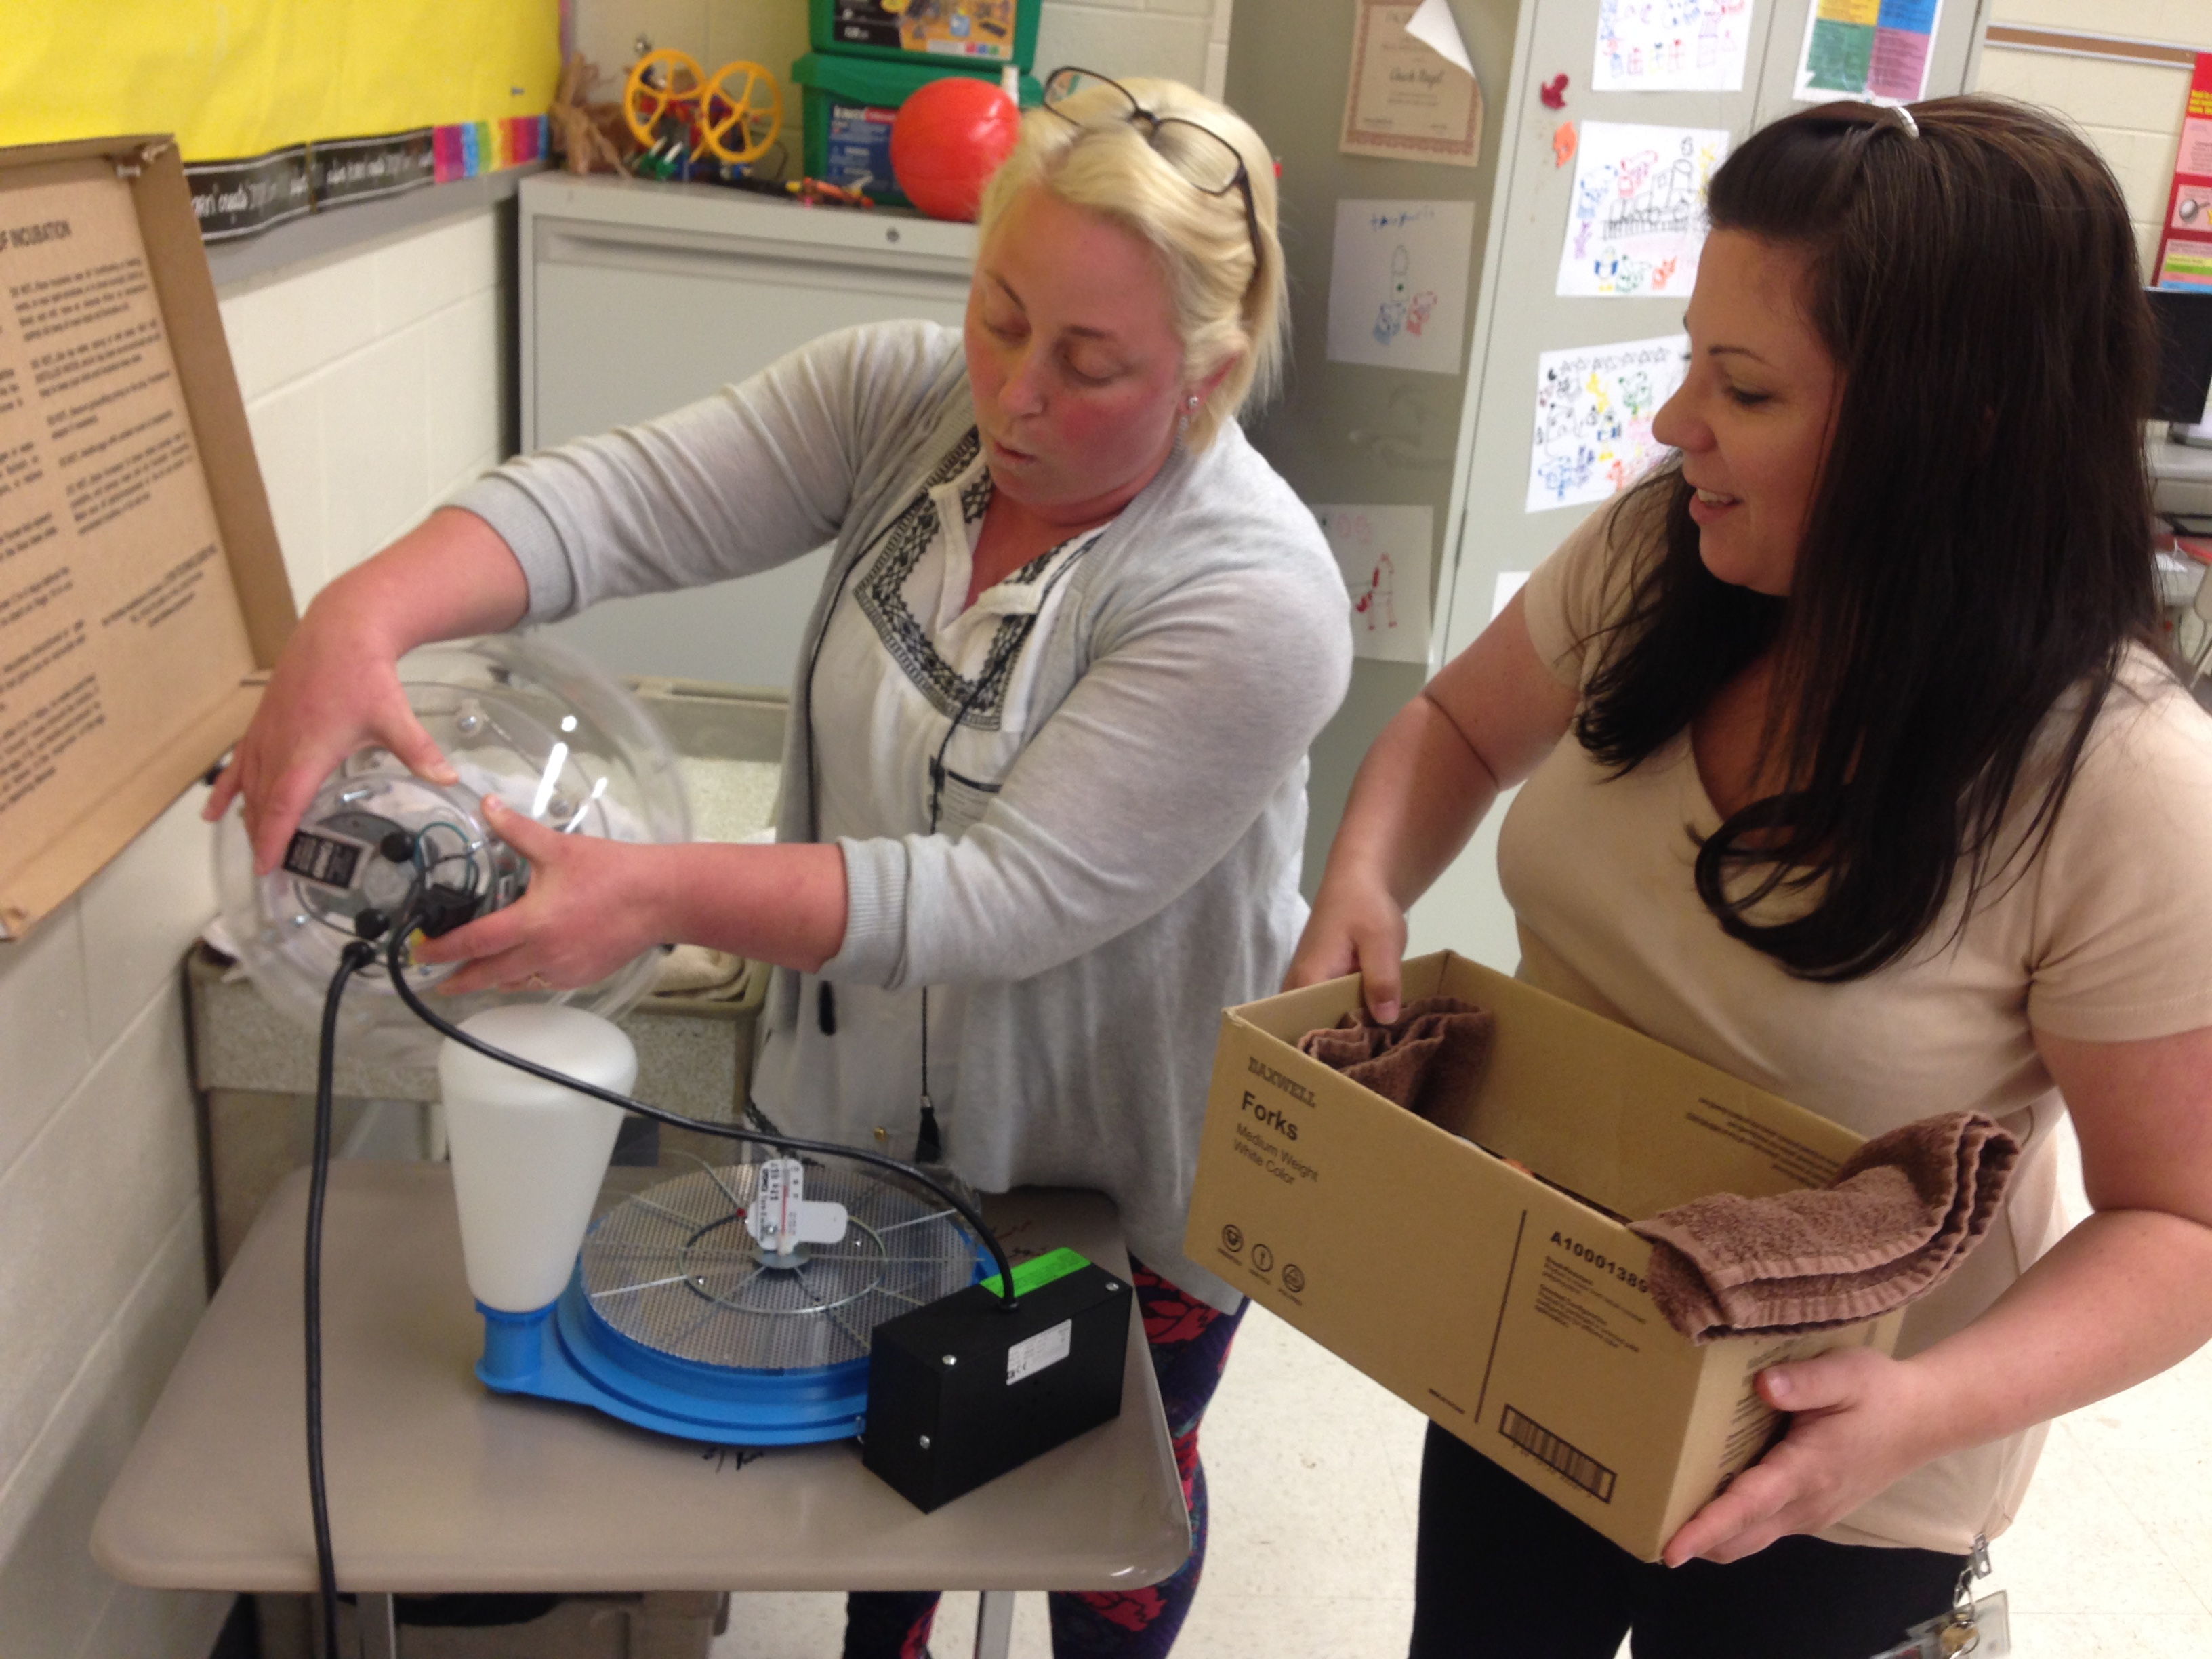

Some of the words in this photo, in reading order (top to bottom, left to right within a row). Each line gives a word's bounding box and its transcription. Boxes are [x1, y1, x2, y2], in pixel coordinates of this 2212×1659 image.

[1248, 1057, 1317, 1109] DAXWELL
[1242, 1090, 1298, 1141] Forks
[1233, 1139, 1263, 1166] White
[1265, 1160, 1296, 1185] Color
[1236, 1123, 1278, 1157] Medium
[1281, 1149, 1319, 1183] Weight
